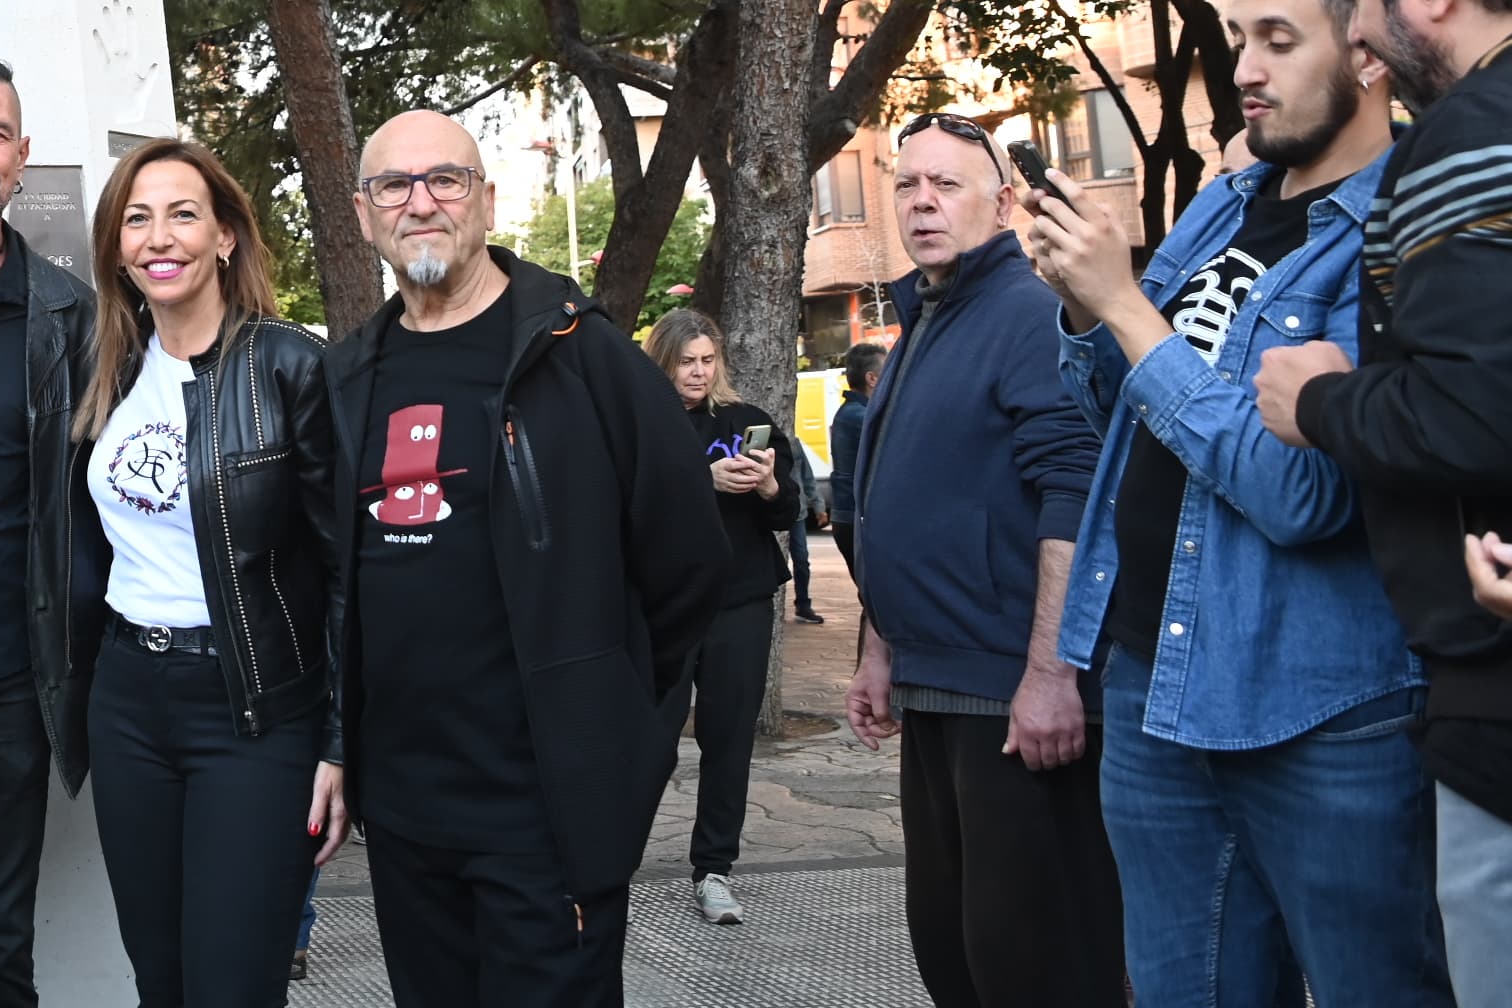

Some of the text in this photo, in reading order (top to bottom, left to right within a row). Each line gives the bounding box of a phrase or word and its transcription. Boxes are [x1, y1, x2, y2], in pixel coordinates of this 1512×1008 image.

[37, 192, 69, 201] CIUDAD
[48, 254, 73, 267] OES
[383, 533, 433, 544] who is there?
